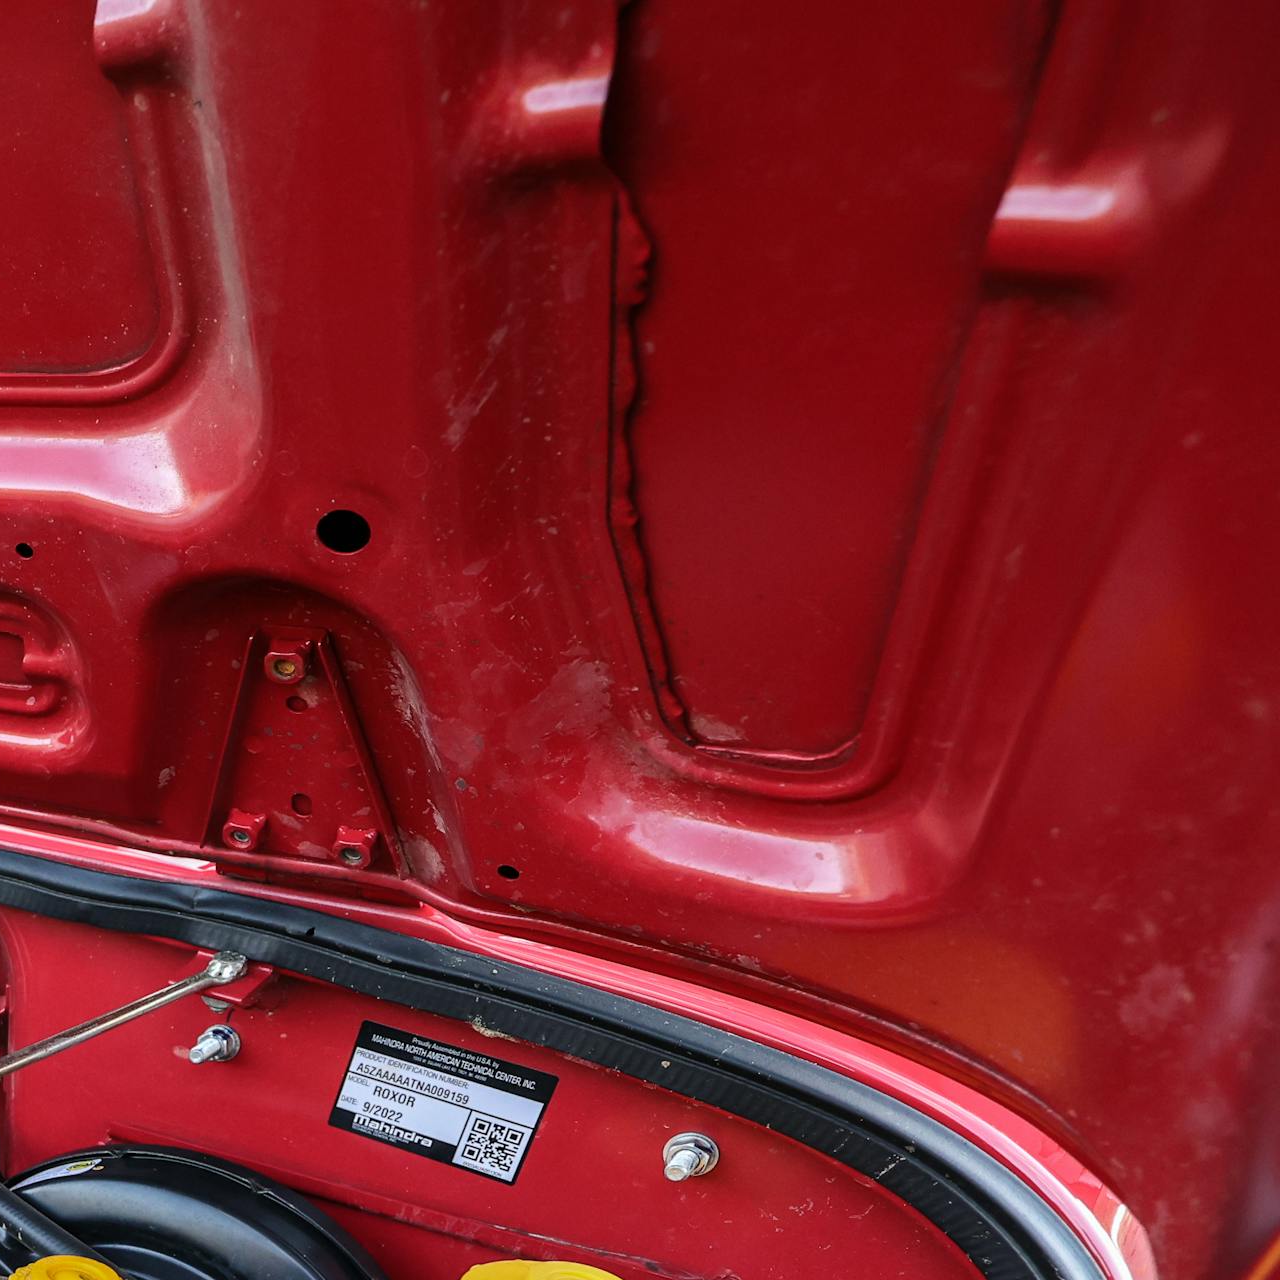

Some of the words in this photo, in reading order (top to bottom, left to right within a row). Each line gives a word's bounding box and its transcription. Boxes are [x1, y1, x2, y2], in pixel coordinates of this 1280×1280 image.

[431, 1043, 461, 1057] Assembled
[356, 1049, 387, 1064] PRODUCT
[387, 1059, 439, 1079] IDENTIFICATION
[437, 1074, 469, 1089] NUMBER:
[370, 1033, 405, 1050] MAHINDRA
[404, 1043, 427, 1057] NORTH
[425, 1050, 461, 1067] AMERICAN
[459, 1060, 495, 1077] TECHNICAL
[493, 1070, 524, 1086] CENTER,
[522, 1078, 537, 1090] INC.
[372, 1085, 416, 1107] ROXOR
[361, 1101, 403, 1123] 9/2022
